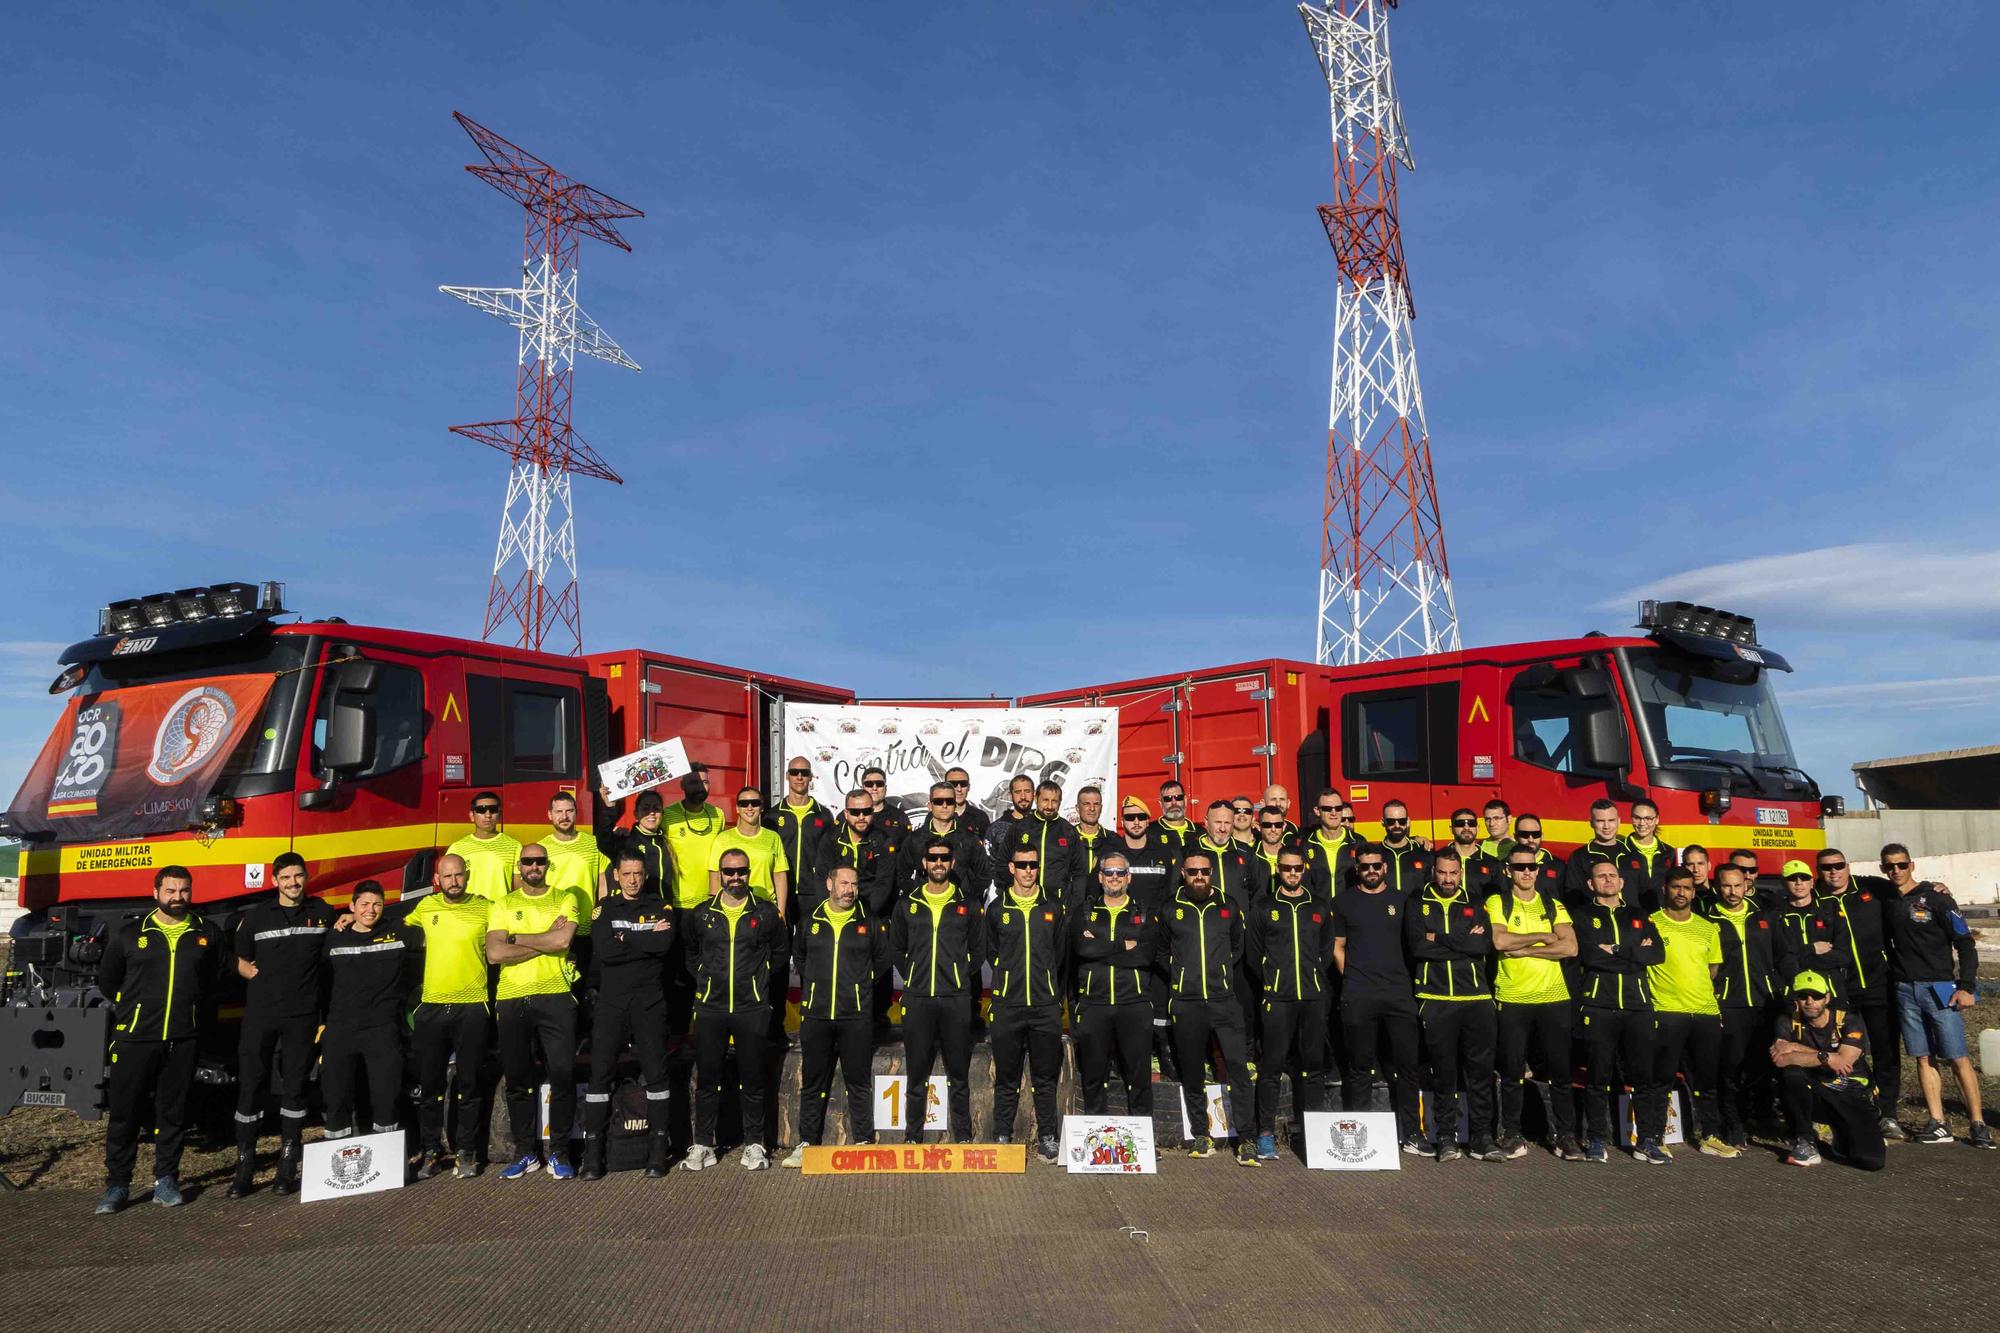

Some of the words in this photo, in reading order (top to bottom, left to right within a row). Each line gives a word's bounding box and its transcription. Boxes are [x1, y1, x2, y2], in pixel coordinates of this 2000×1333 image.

[78, 707, 102, 724] OCR
[940, 730, 970, 764] el
[1753, 828, 1773, 837] UNIDAD
[1774, 829, 1793, 837] MILITAR
[1752, 838, 1760, 847] DE
[1761, 838, 1797, 848] EMERGENCIAS
[80, 848, 113, 859] UNIDAD
[115, 845, 151, 857] MILITAR
[76, 860, 87, 870] DE
[89, 857, 153, 869] EMERGENCIAS
[26, 1093, 63, 1105] BUCHER
[882, 1080, 900, 1127] 1
[831, 1149, 898, 1170] CONTRA
[903, 1149, 920, 1170] EL
[963, 1149, 998, 1170] RACE
